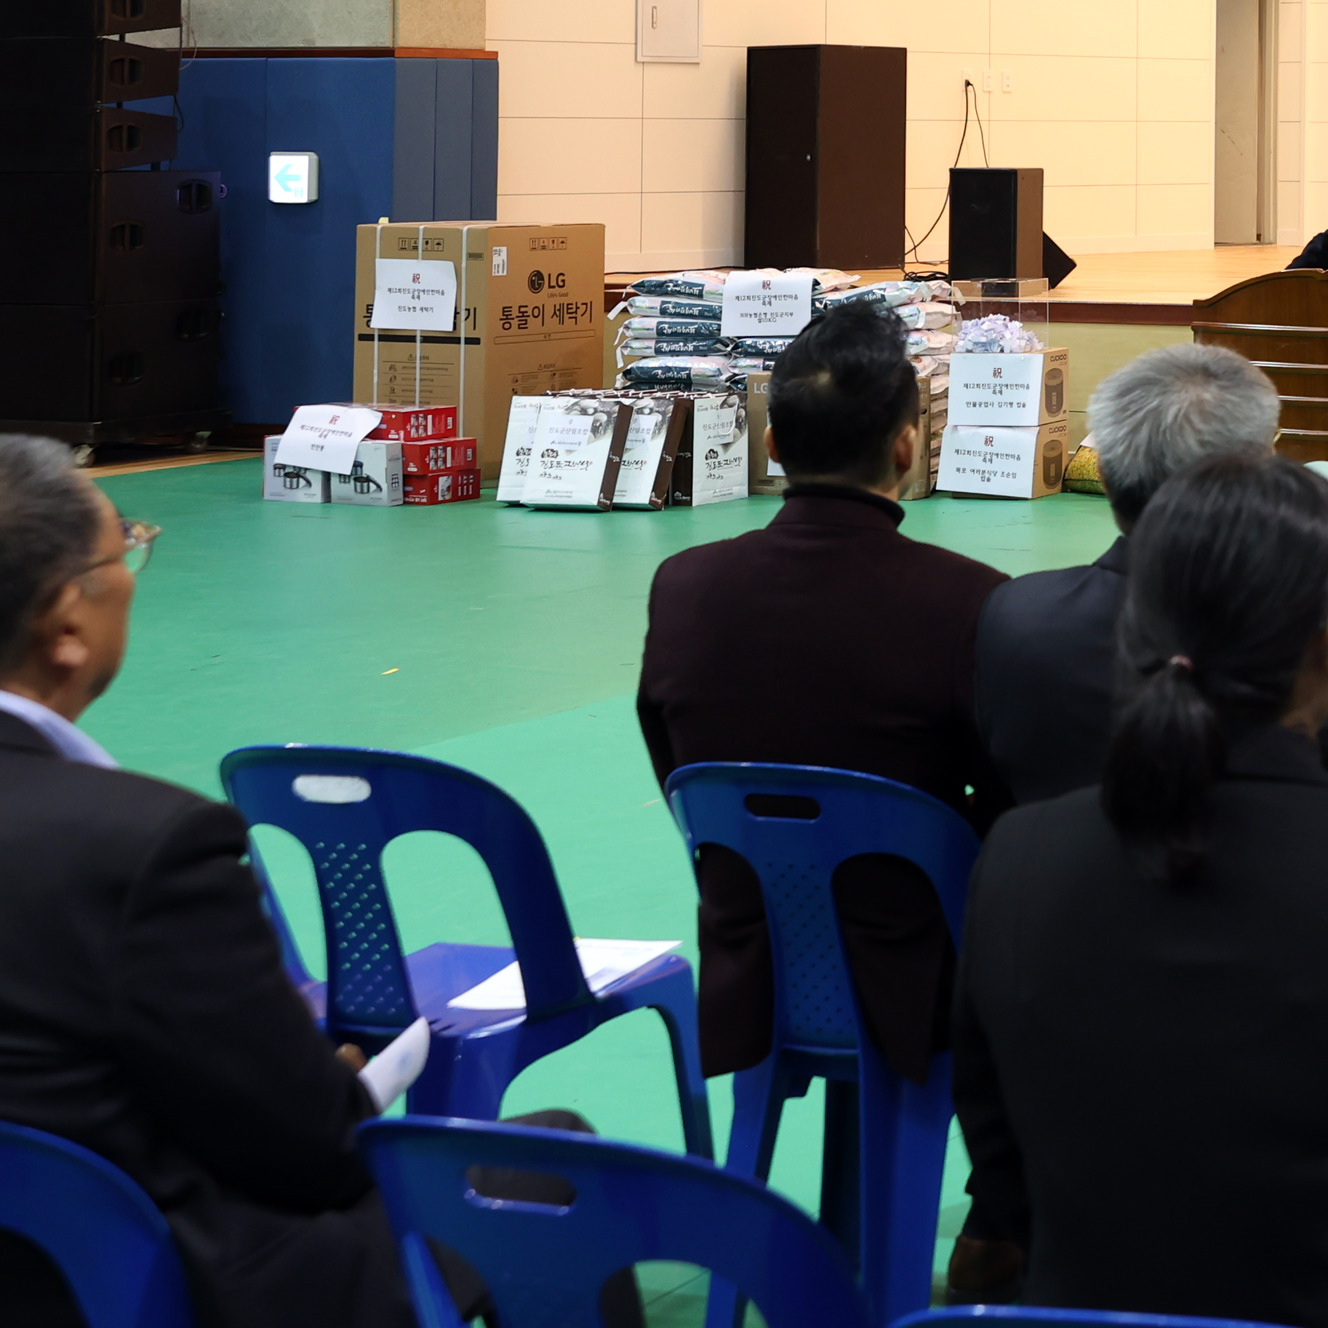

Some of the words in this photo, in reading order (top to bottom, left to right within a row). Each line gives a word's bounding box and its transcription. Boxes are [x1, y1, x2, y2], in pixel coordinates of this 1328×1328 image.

[547, 272, 566, 290] LG
[499, 303, 545, 331] 통돌이
[550, 301, 593, 327] 세탁기
[992, 367, 1003, 379] 祝
[984, 435, 994, 447] 祝
